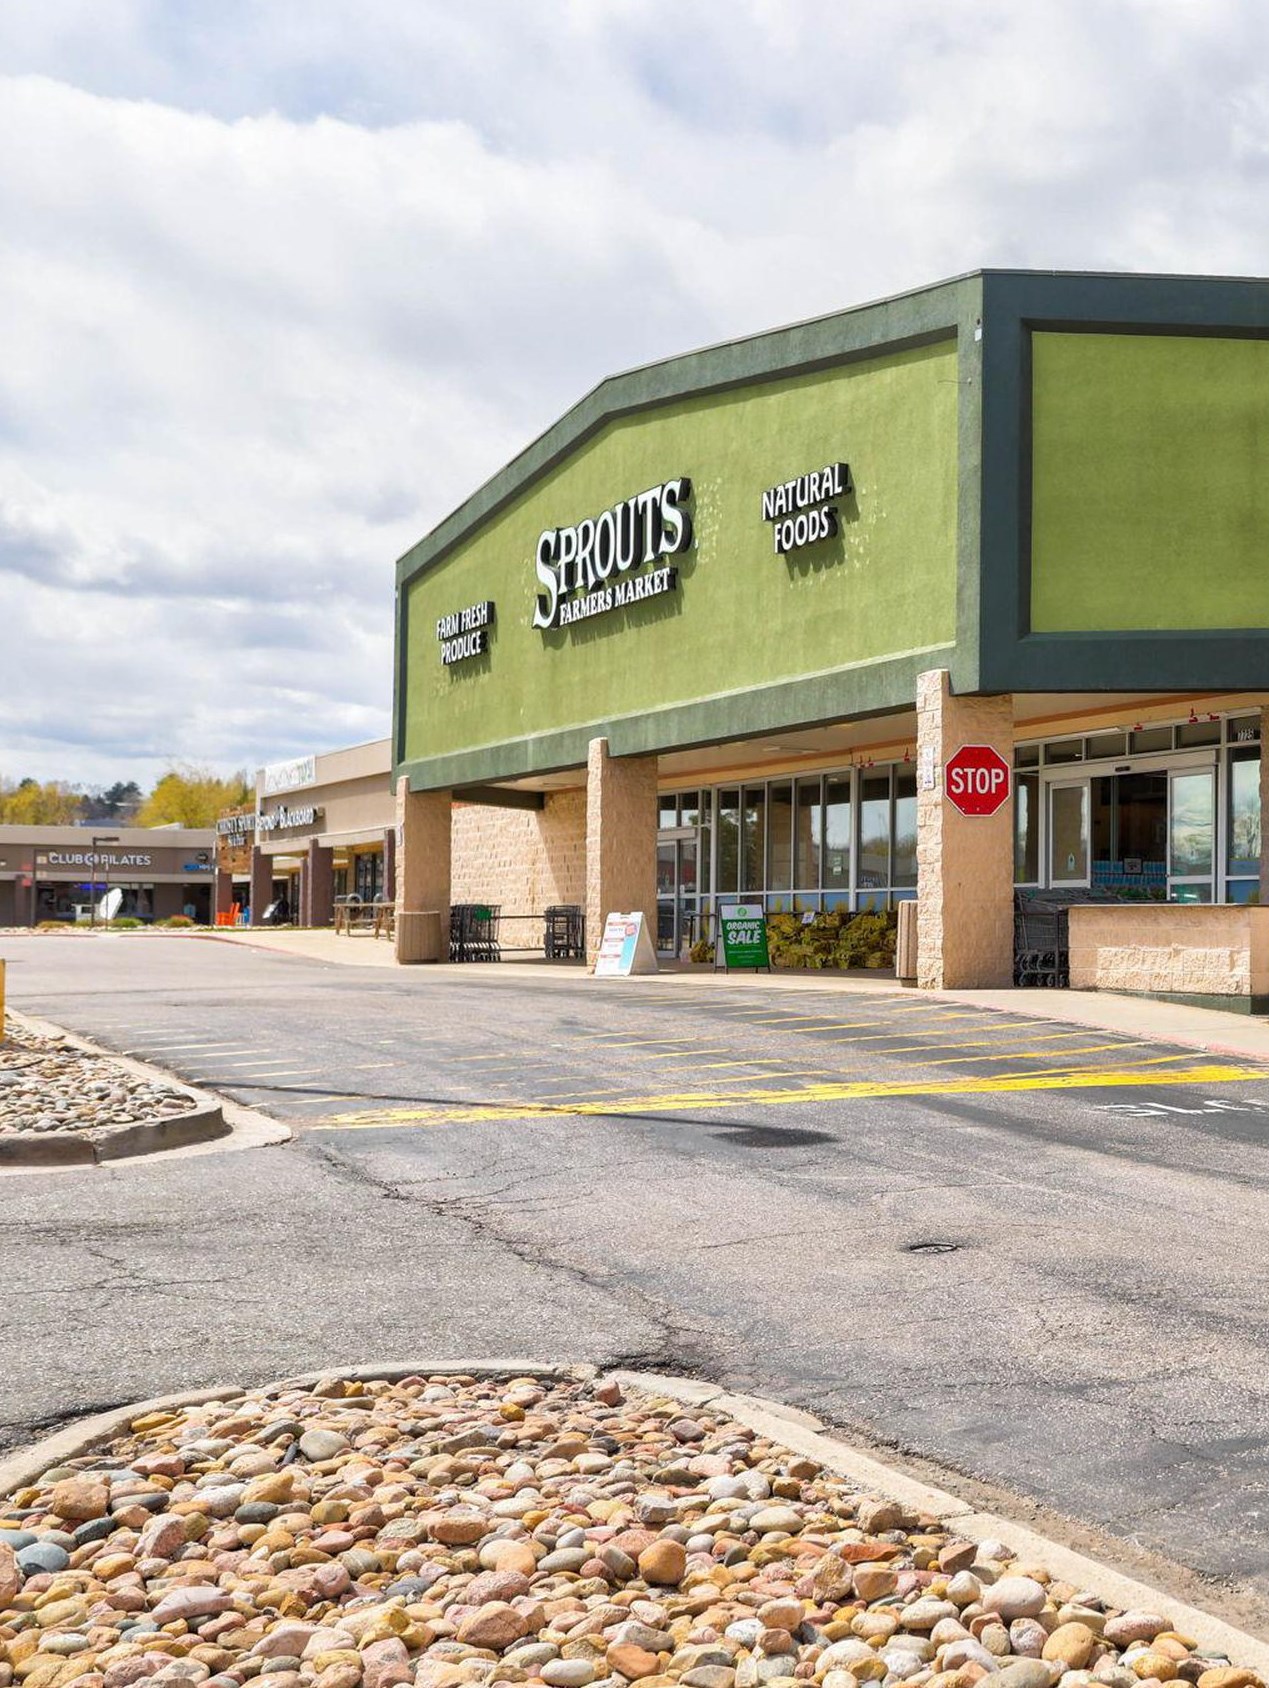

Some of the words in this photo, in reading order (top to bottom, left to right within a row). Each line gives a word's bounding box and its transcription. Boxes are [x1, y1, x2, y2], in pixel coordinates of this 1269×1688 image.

[762, 463, 845, 521] NATURAL
[774, 508, 830, 554] FOODS
[532, 477, 687, 630] SPROUTS
[559, 586, 613, 627] FARMERS
[615, 568, 672, 607] MARKET
[436, 612, 459, 641] FARM
[460, 602, 489, 632] FRESH
[441, 630, 483, 665] PRODUCE
[950, 767, 1005, 795] STOP
[48, 851, 83, 865] CLUB
[100, 853, 152, 866] PILATES
[726, 920, 760, 930] ORGANIC
[727, 930, 761, 945] SALE
